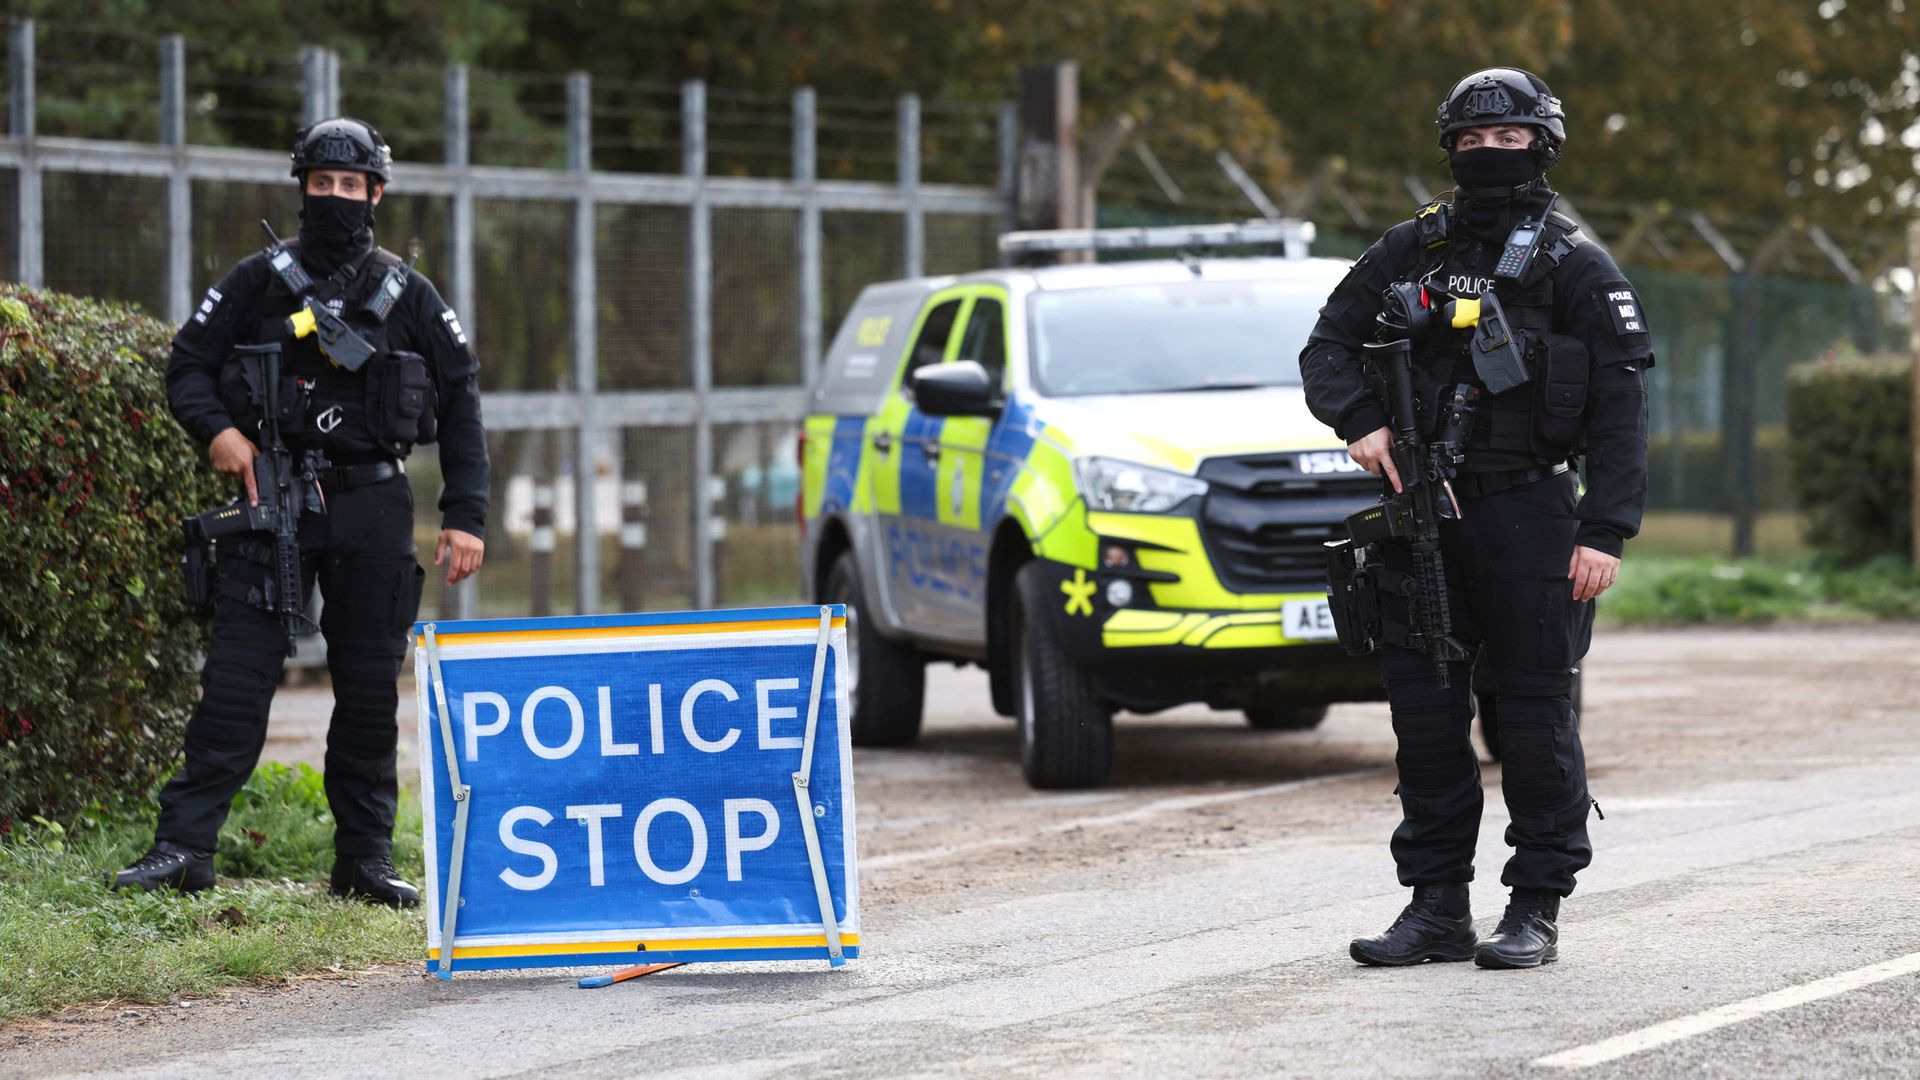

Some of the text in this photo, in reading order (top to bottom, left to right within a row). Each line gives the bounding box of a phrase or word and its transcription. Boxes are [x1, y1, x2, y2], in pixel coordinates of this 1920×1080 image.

[1448, 275, 1496, 294] POLICE
[1608, 291, 1634, 301] POLICE
[1618, 304, 1636, 318] MD
[1299, 452, 1365, 474] ISU
[463, 678, 804, 762] POLICE
[499, 797, 781, 891] STOP
